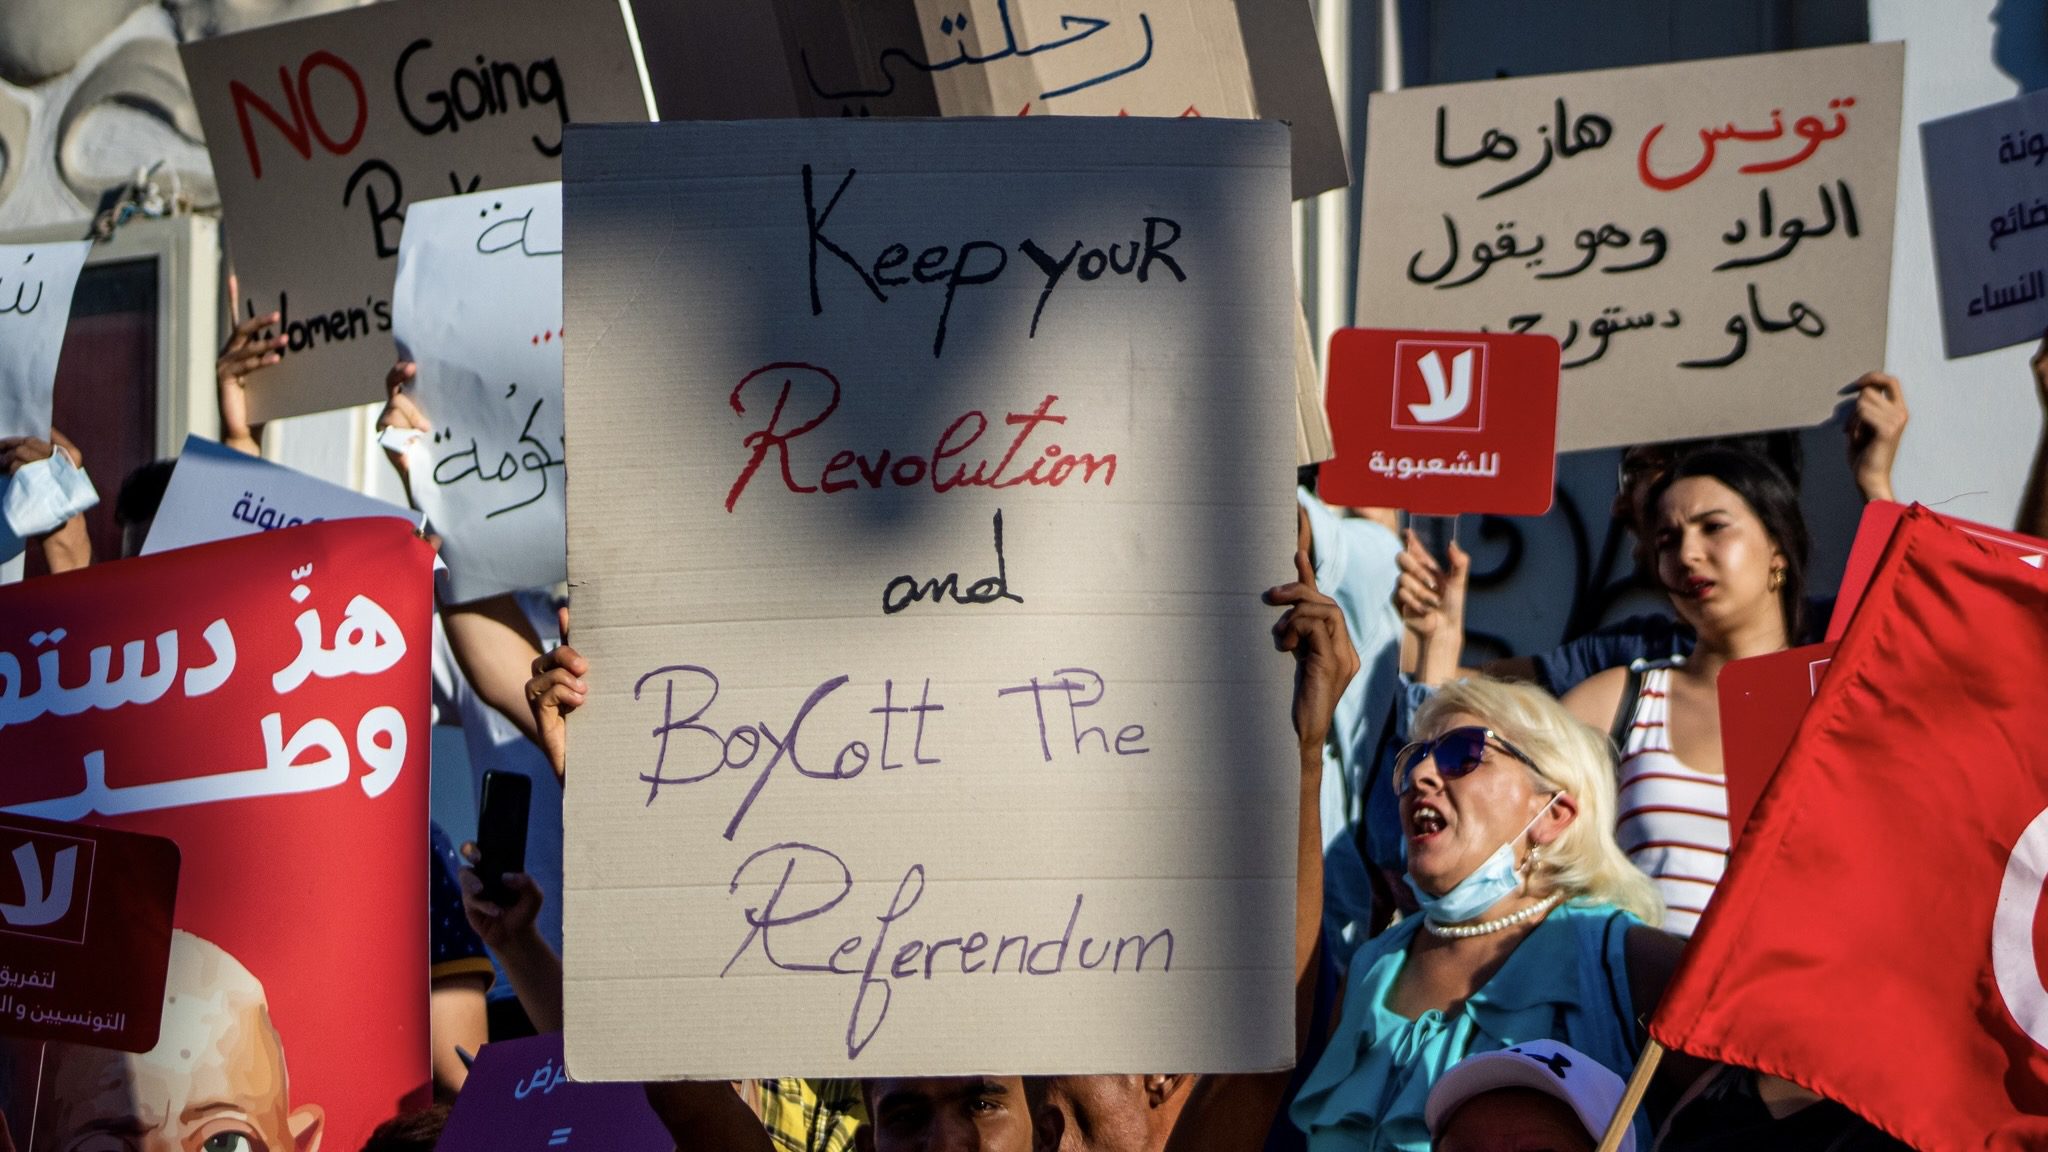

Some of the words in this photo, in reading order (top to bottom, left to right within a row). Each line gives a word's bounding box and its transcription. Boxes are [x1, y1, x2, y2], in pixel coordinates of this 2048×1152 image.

[229, 50, 368, 179] NO
[394, 38, 569, 157] Going
[1434, 97, 1612, 198] هازها
[1637, 96, 1856, 191] تونس
[801, 164, 1007, 359] Keep
[1406, 213, 1545, 289] يقول
[1535, 222, 1668, 279] وهو
[1713, 178, 1861, 272] الواد
[1561, 306, 1681, 369] دستور
[1679, 283, 1827, 367] هاو
[1407, 348, 1473, 424] لا
[725, 361, 1118, 513] Revolution
[1368, 450, 1500, 479] للشعبوية
[882, 508, 1023, 614] and
[999, 667, 1150, 762] The
[0, 840, 78, 926] لا
[720, 842, 1175, 1060] Referendum
[30, 1004, 126, 1031] التونسيين
